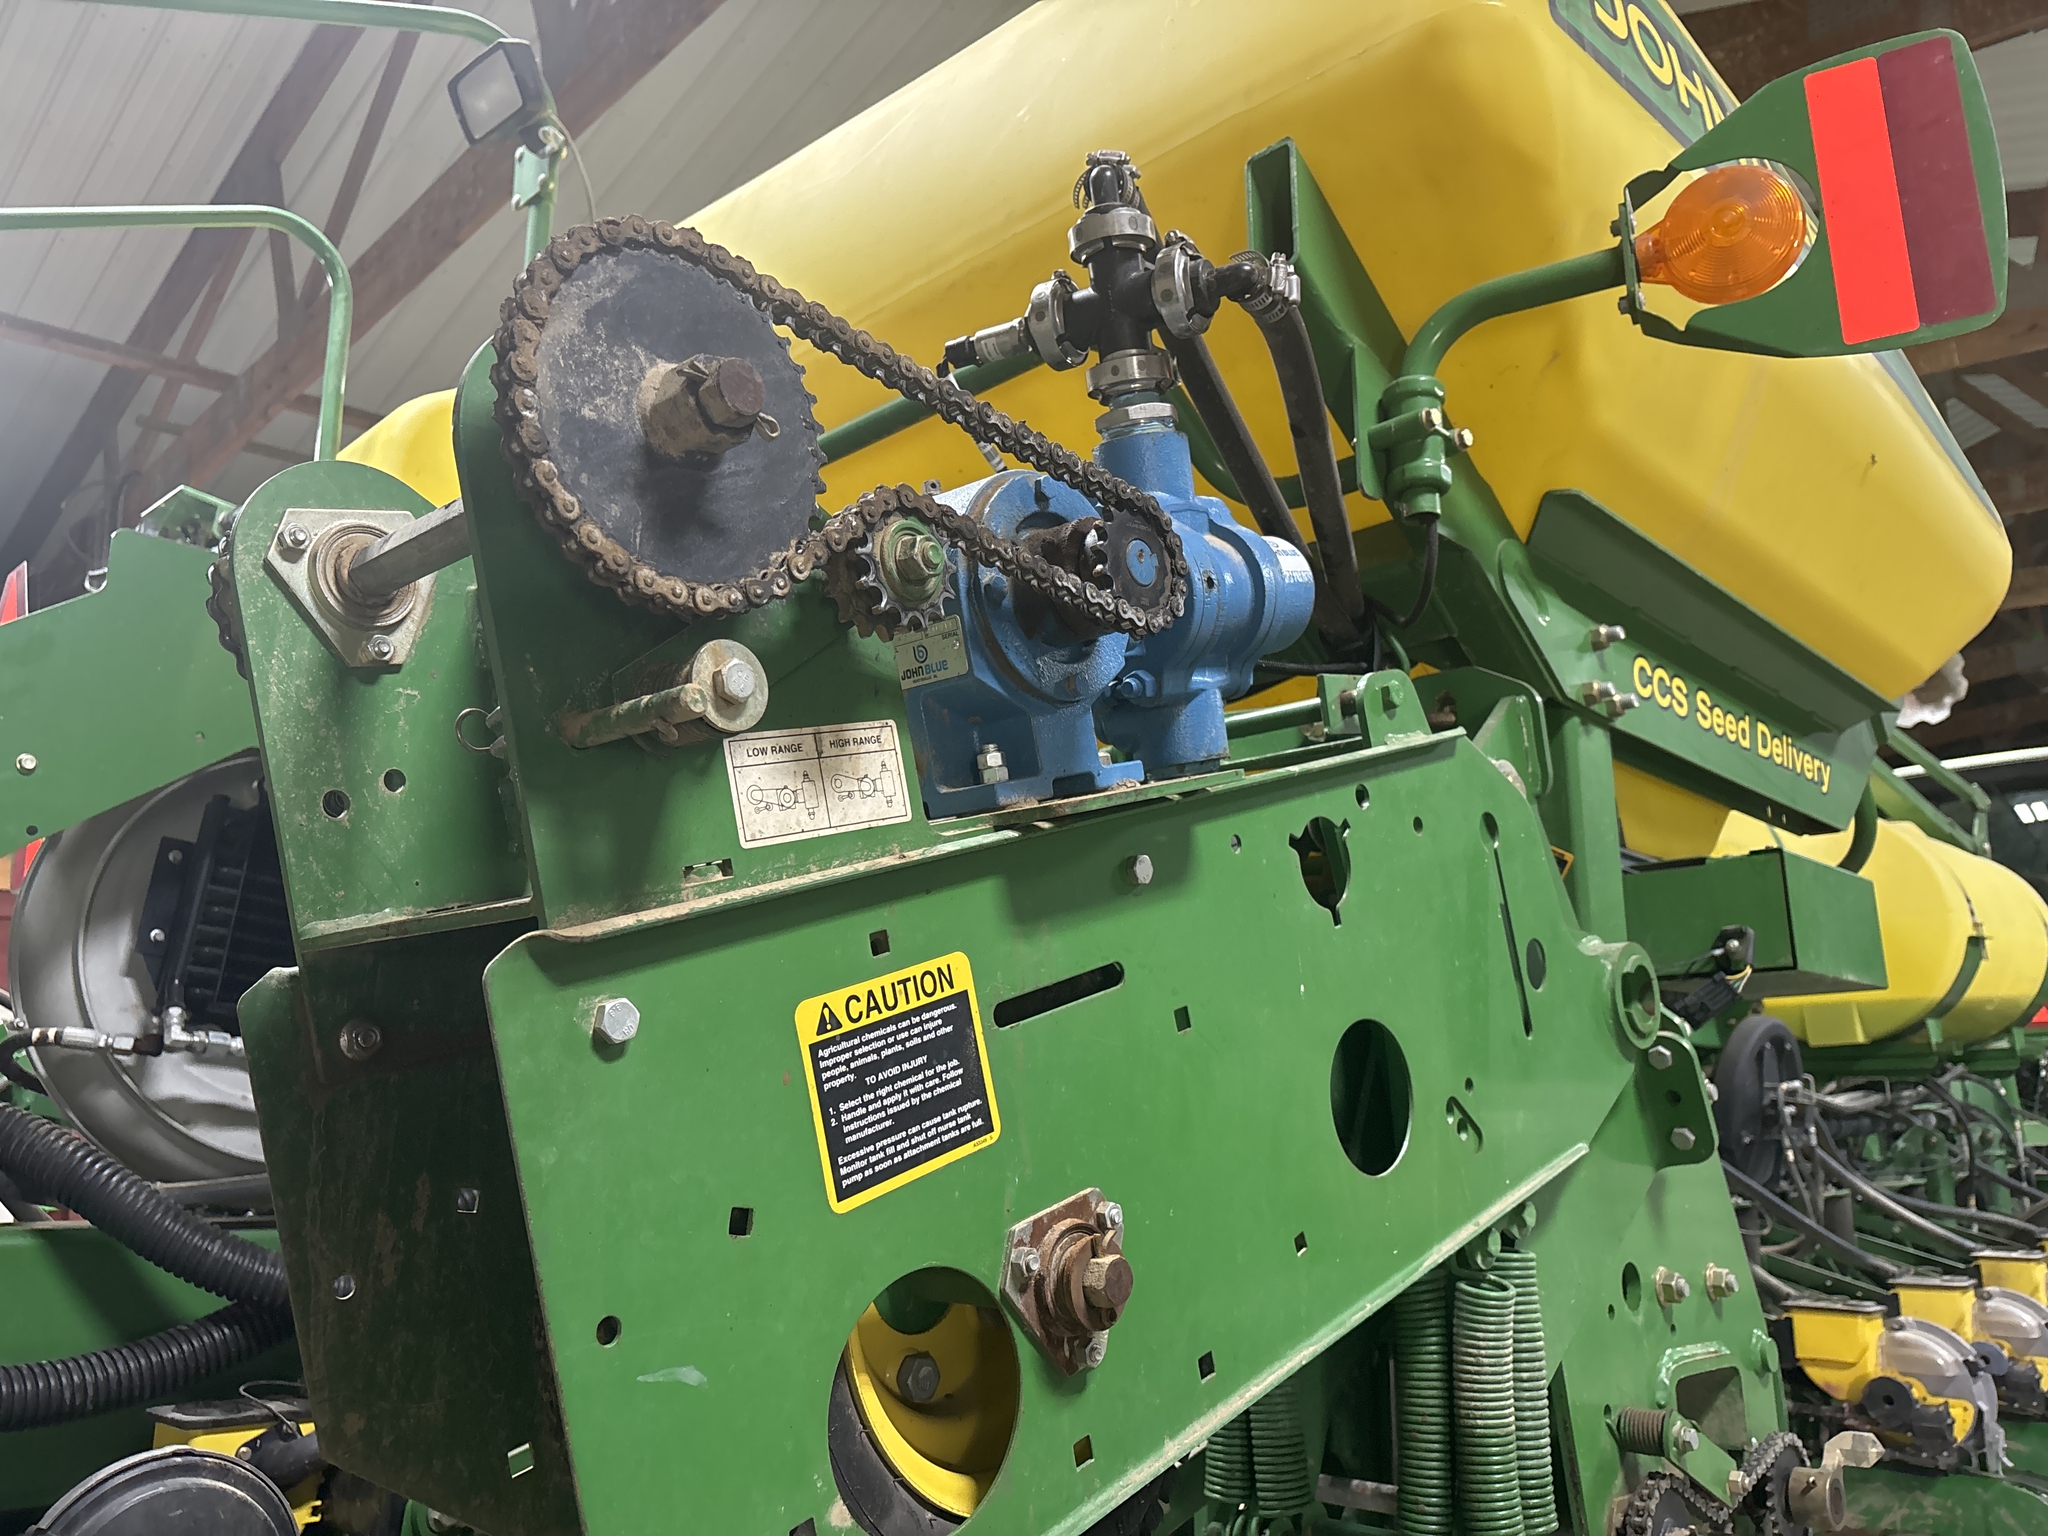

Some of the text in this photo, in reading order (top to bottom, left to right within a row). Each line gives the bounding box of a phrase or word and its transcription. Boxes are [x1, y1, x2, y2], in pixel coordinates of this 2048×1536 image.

[746, 743, 804, 758] LOW RANGE
[830, 734, 882, 748] HIGH RANGE
[1632, 656, 1832, 794] CCS Seed Delivery
[845, 964, 954, 1023] CAUTION
[818, 1003, 957, 1058] Agricultural chemicals can be dangerous.
[819, 1018, 942, 1068] Improper selection or use can injure
[821, 1024, 953, 1081] people, animals, plants, soils and other
[823, 1073, 857, 1092] property.
[828, 1058, 960, 1115] 1. Select the right chemical for the job.
[830, 1067, 963, 1126] 2. Handle and apply it with care. Follow
[864, 1054, 927, 1085] TO AVOID INJURY
[837, 1098, 982, 1165] Excessive pressure can cause tank rupture.
[842, 1077, 962, 1133] instructions issued by the chemical
[845, 1119, 895, 1144] manufacturer.
[839, 1112, 972, 1176] Monitor tank fill and shut off nurse tank
[842, 1118, 984, 1188] pump as soon as attachment tanks are full.
